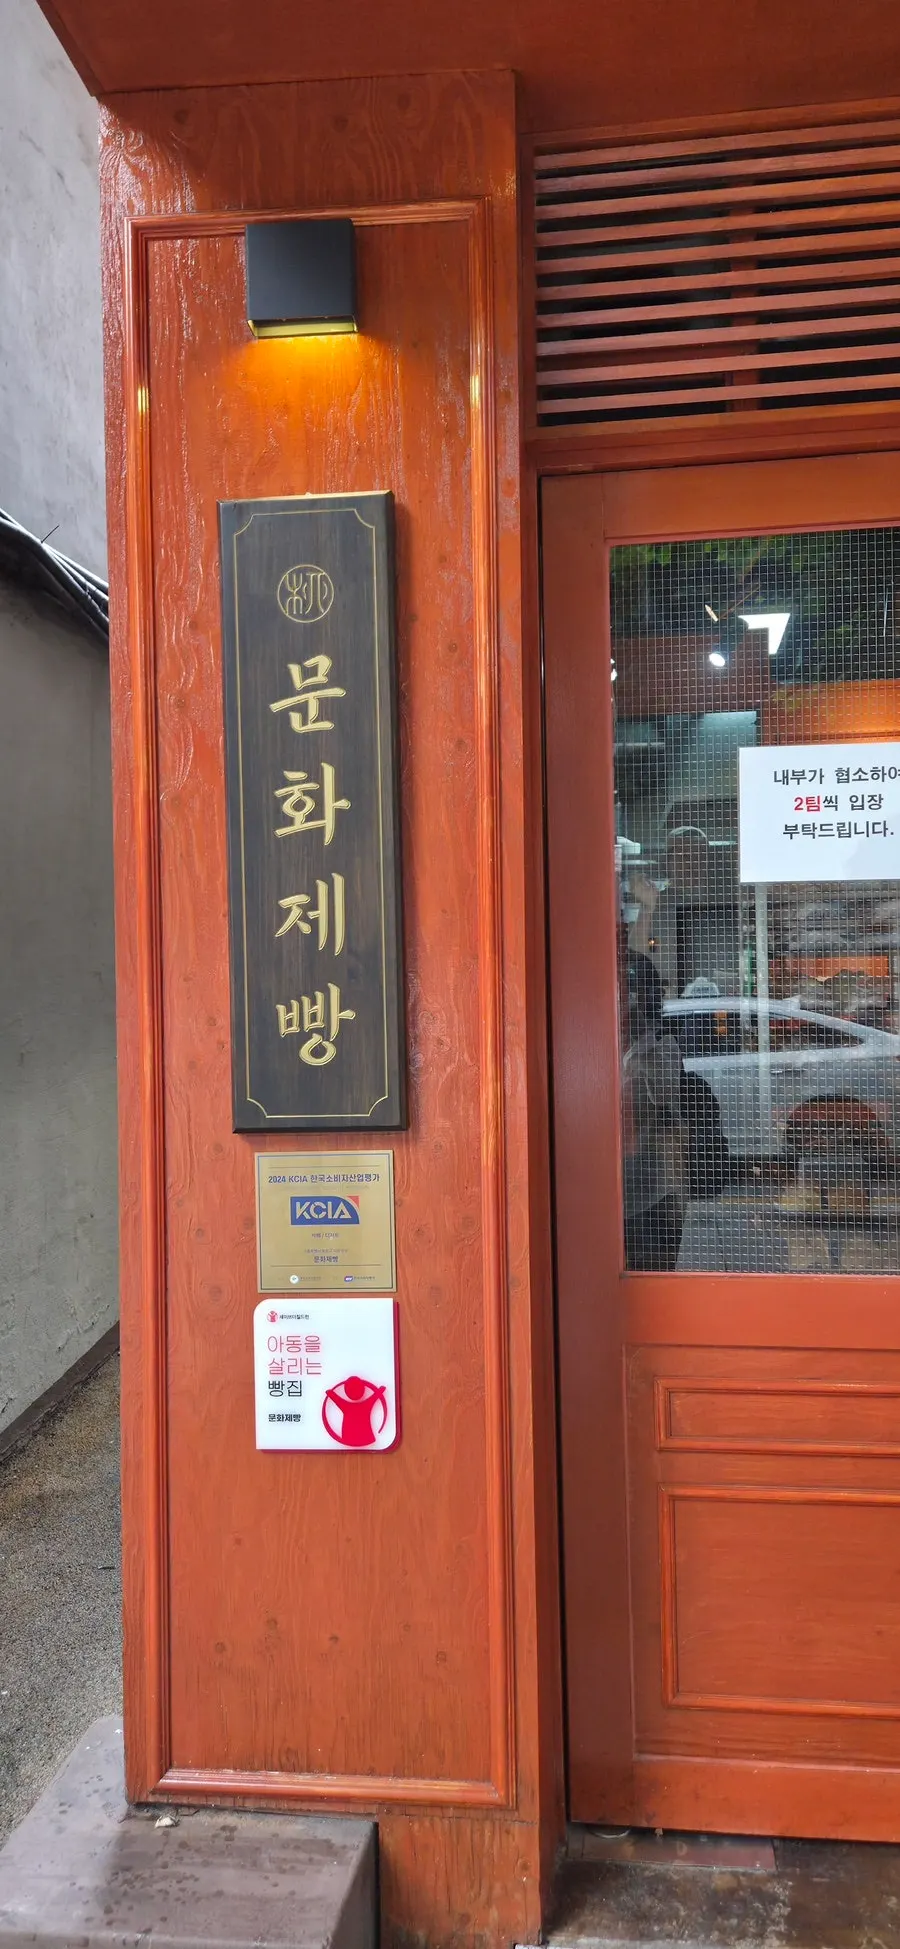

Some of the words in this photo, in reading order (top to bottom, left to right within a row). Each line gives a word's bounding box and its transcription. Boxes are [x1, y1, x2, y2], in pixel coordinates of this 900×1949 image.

[773, 768, 825, 785] 내부가
[794, 794, 838, 812] 2팀씩
[849, 793, 884, 811] 입장
[783, 820, 894, 840] 부탁드립니다.
[269, 655, 356, 1067] 문화제빵
[268, 1175, 287, 1184] 2024
[288, 1175, 308, 1183] KCIA
[310, 1173, 380, 1183] 한국소비자산업평가
[296, 1201, 352, 1220] KCIA
[267, 1335, 321, 1353] 아동을
[267, 1357, 322, 1376] 살리는
[268, 1380, 303, 1398] 빵집
[268, 1413, 302, 1423] 문화제빵
